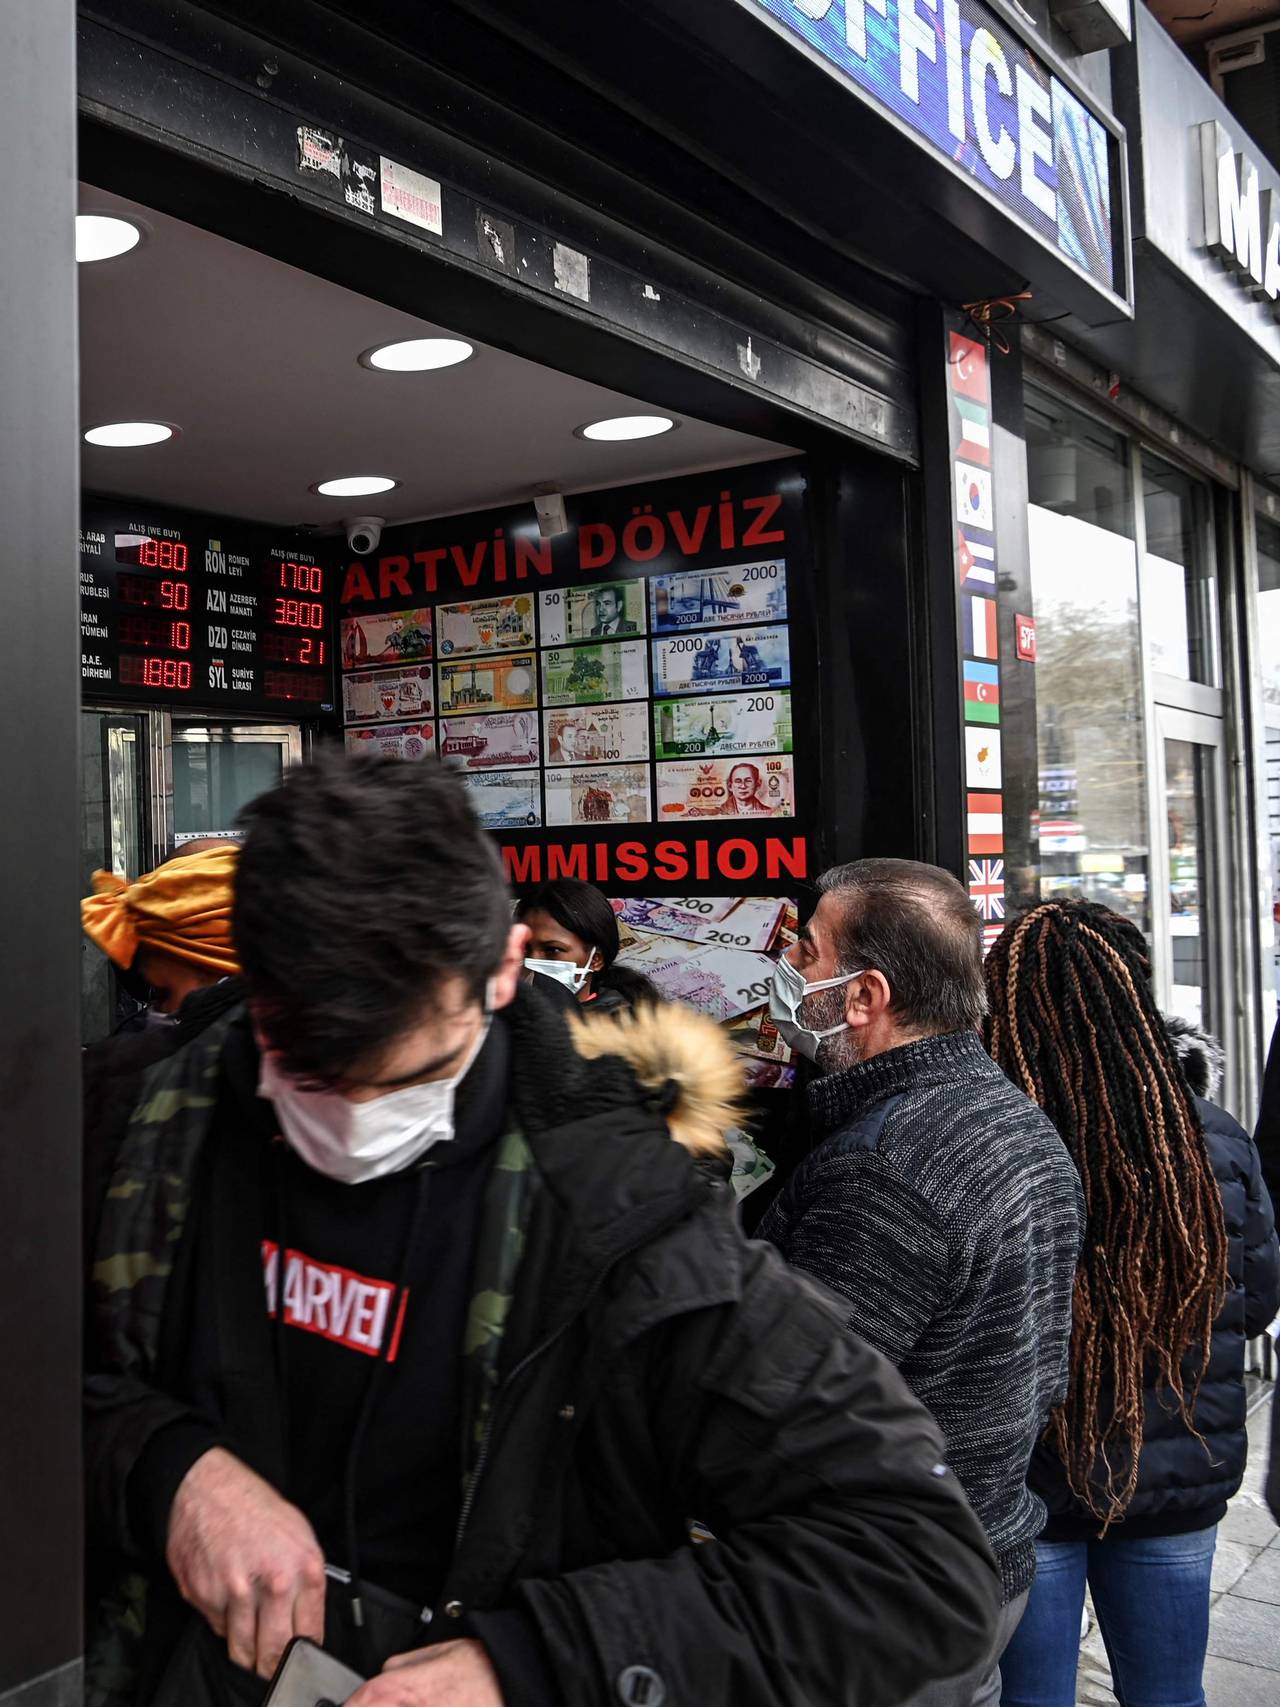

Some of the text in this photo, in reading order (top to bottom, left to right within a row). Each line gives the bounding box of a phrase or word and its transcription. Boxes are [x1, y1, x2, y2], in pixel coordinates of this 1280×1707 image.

[793, 0, 1059, 223] FICE
[86, 531, 106, 543] ARAB
[163, 528, 181, 540] BUY)
[340, 490, 785, 604] ARTVİN DÖVİZ
[205, 550, 250, 575] RON ROMEN
[80, 573, 94, 583] RUS
[228, 566, 243, 577] LEYİ
[741, 564, 778, 582] 2000
[80, 585, 110, 599] RUBLESİ
[206, 589, 227, 613] AZN
[544, 593, 560, 606] 50
[229, 605, 253, 617] MANATI
[675, 613, 698, 624] 2000
[81, 625, 109, 638] TÜMENİ
[208, 625, 228, 649] DZD
[669, 637, 703, 654] 2000
[81, 654, 103, 666] B.A.E.
[548, 652, 560, 662] 50
[82, 666, 112, 679] DİRHEMİ
[208, 665, 228, 689] SYL
[744, 672, 767, 683] 2000
[746, 696, 775, 712] 200
[603, 749, 620, 760] 100
[684, 743, 702, 753] 200
[766, 761, 782, 771] 100
[672, 897, 714, 915] 200
[705, 930, 752, 947] 200
